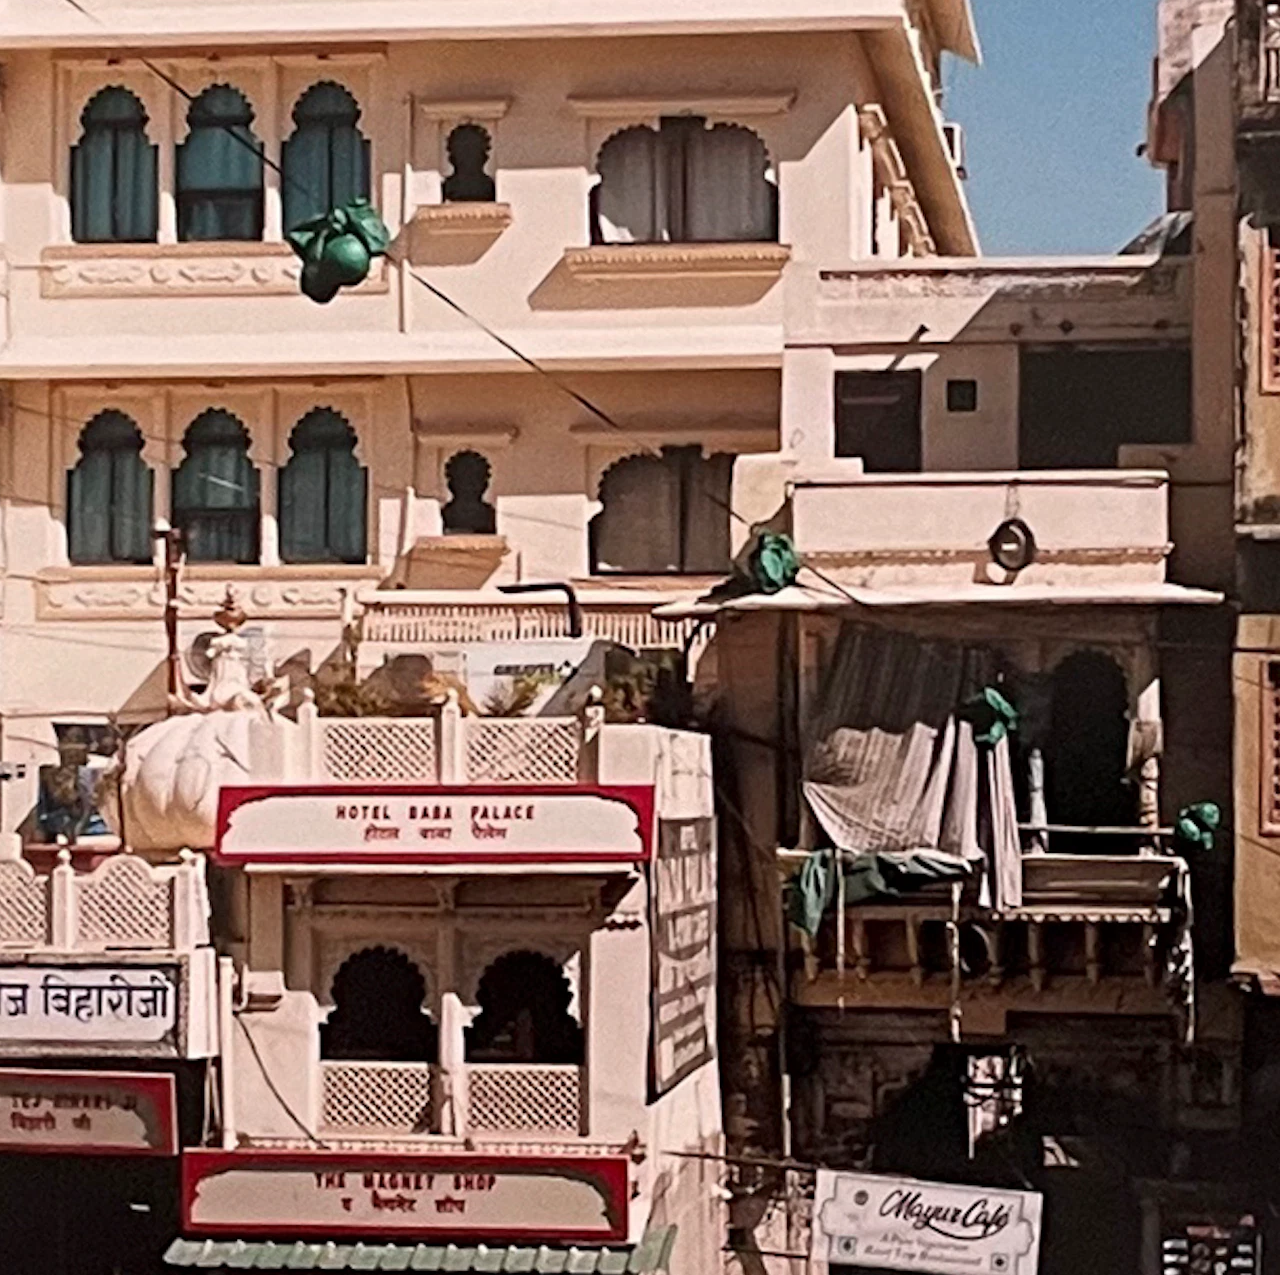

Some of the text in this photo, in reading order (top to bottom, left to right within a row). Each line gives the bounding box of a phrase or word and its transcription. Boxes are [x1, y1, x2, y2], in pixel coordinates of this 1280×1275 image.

[336, 805, 534, 820] HOTEL BABA PALACE
[314, 1172, 496, 1191] THE MAGNET SHOP
[879, 1189, 964, 1231] Mayur
